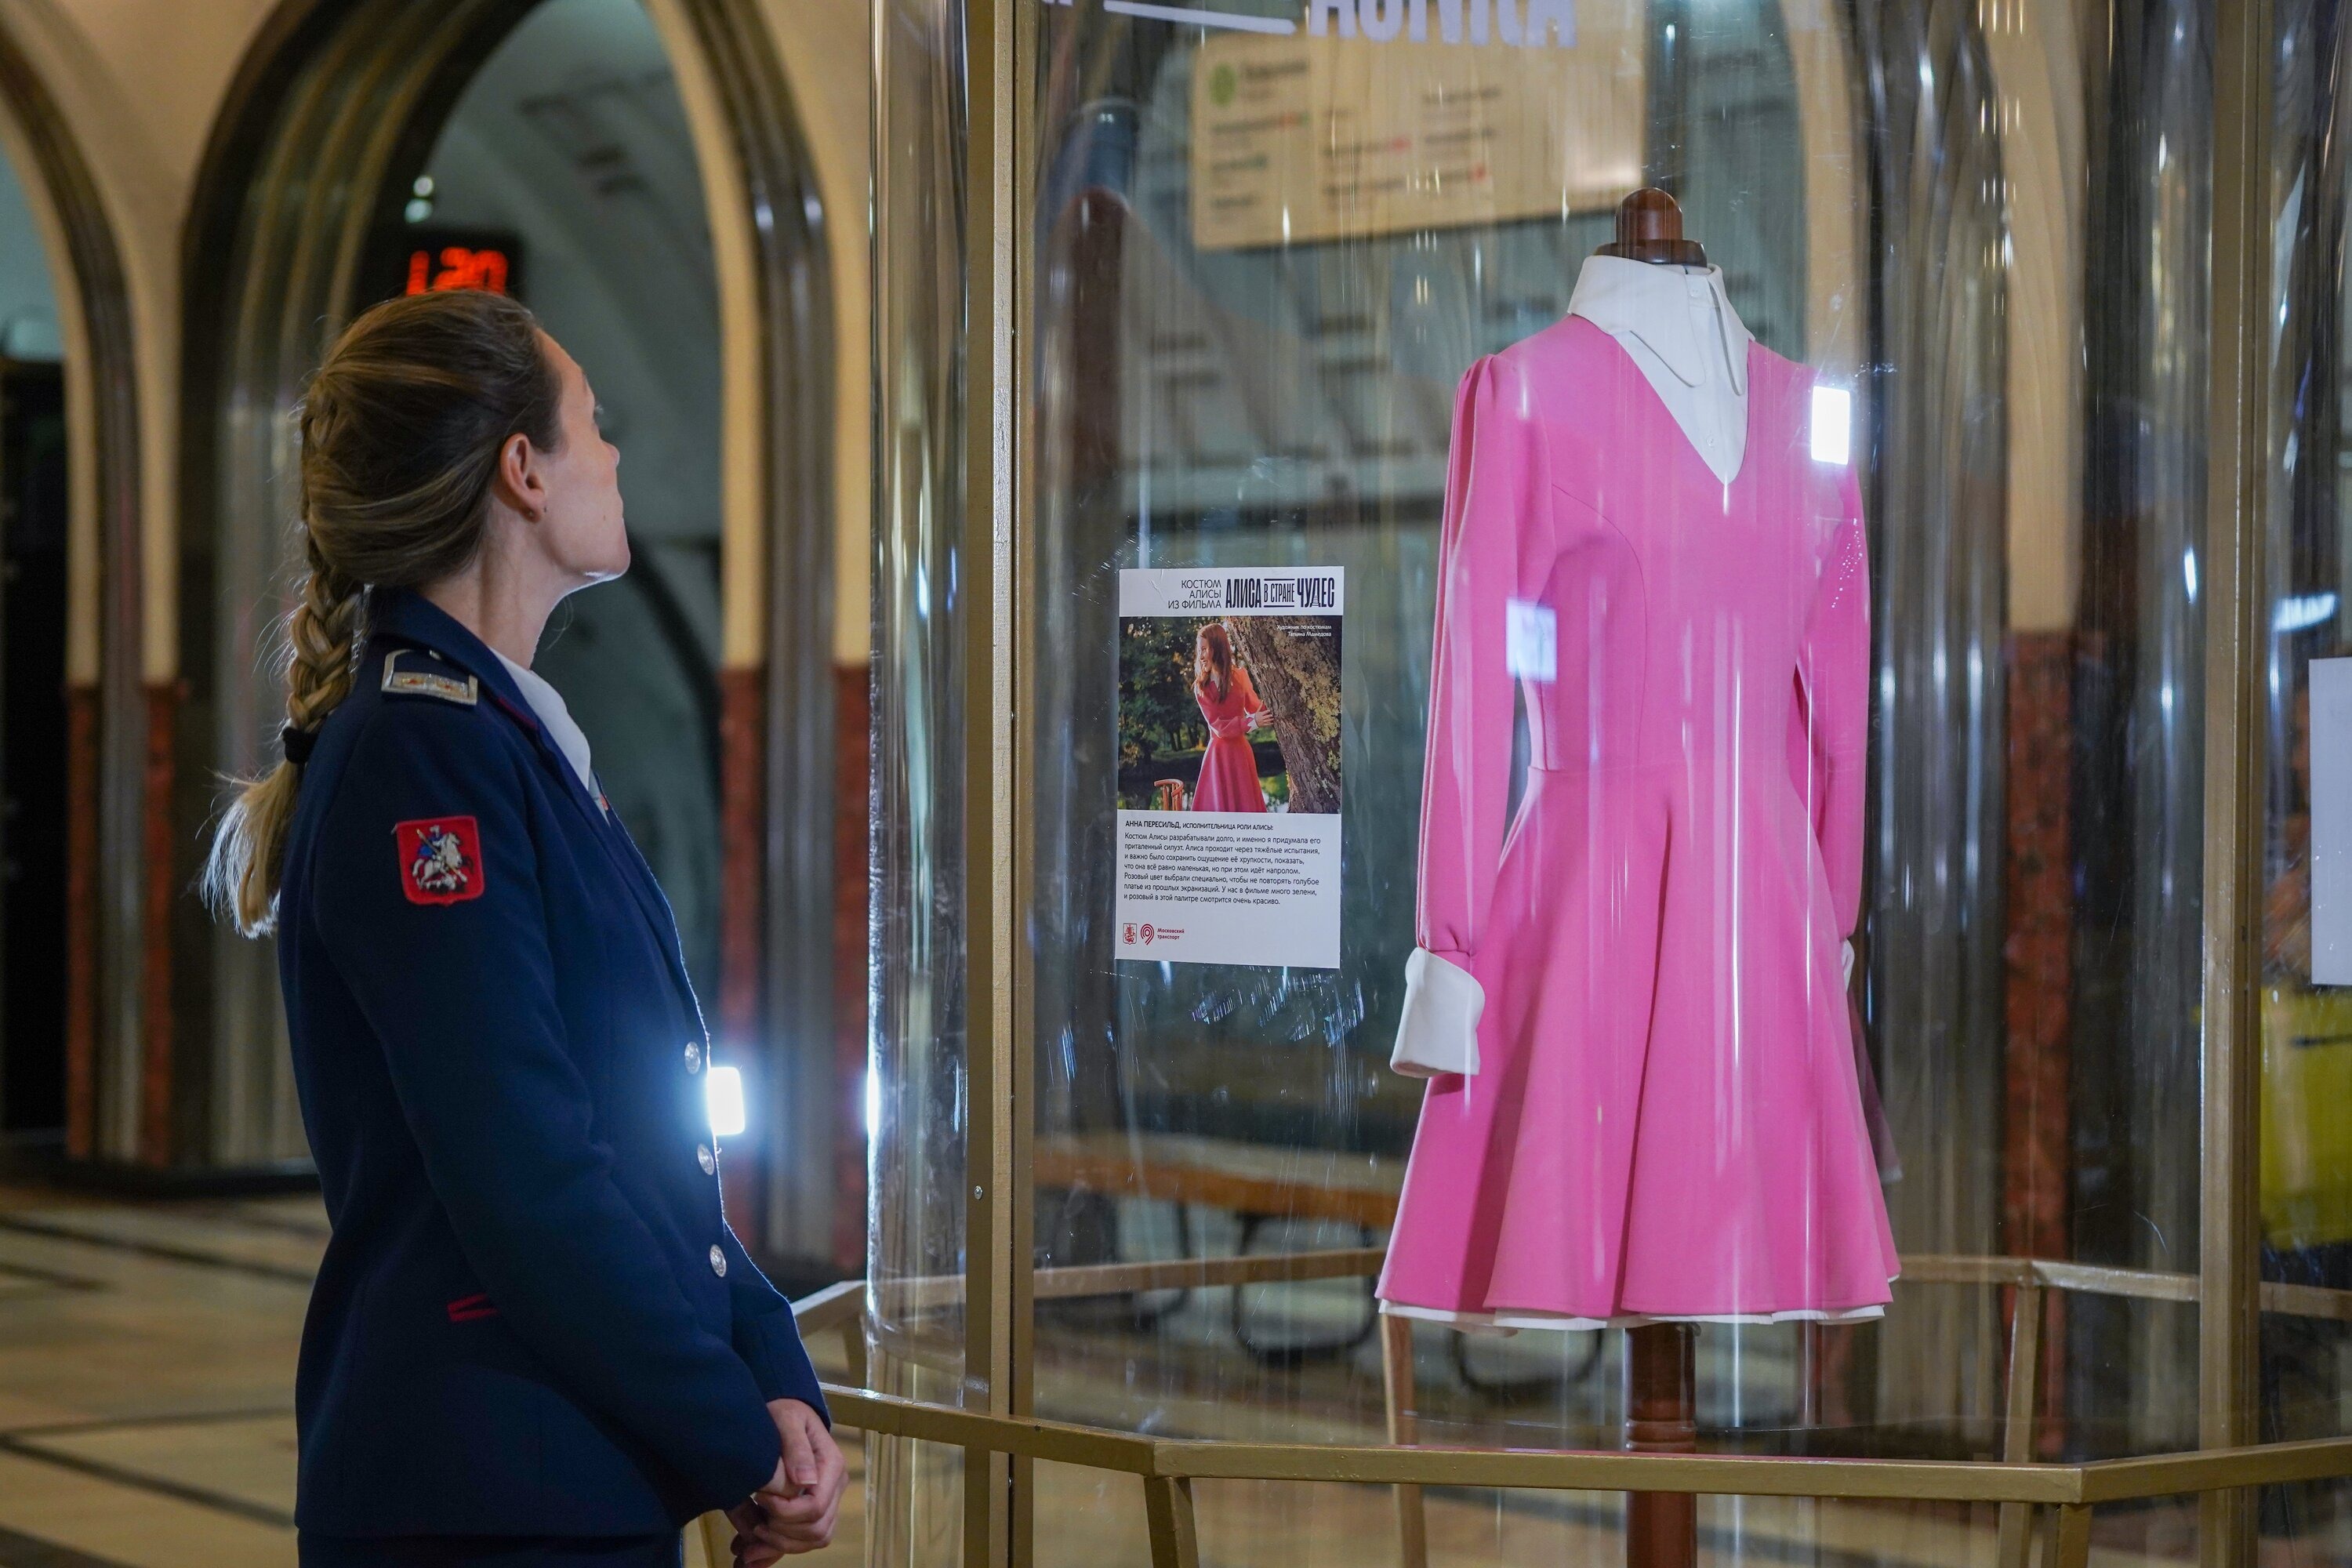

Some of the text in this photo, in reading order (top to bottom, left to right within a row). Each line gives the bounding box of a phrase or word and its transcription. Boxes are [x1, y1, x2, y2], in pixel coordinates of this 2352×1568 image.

[1181, 579, 1221, 588] КОСТЮМ
[1189, 590, 1221, 598] АЛИСЫ
[1225, 578, 1334, 608] АЛИСА В СТРАНЕ ЧУДЕС
[1168, 600, 1221, 608] ИЗ ФИЛЬМА
[1144, 821, 1181, 829] ПЕРЕСИЛЬД,
[1294, 878, 1319, 887] голубое
